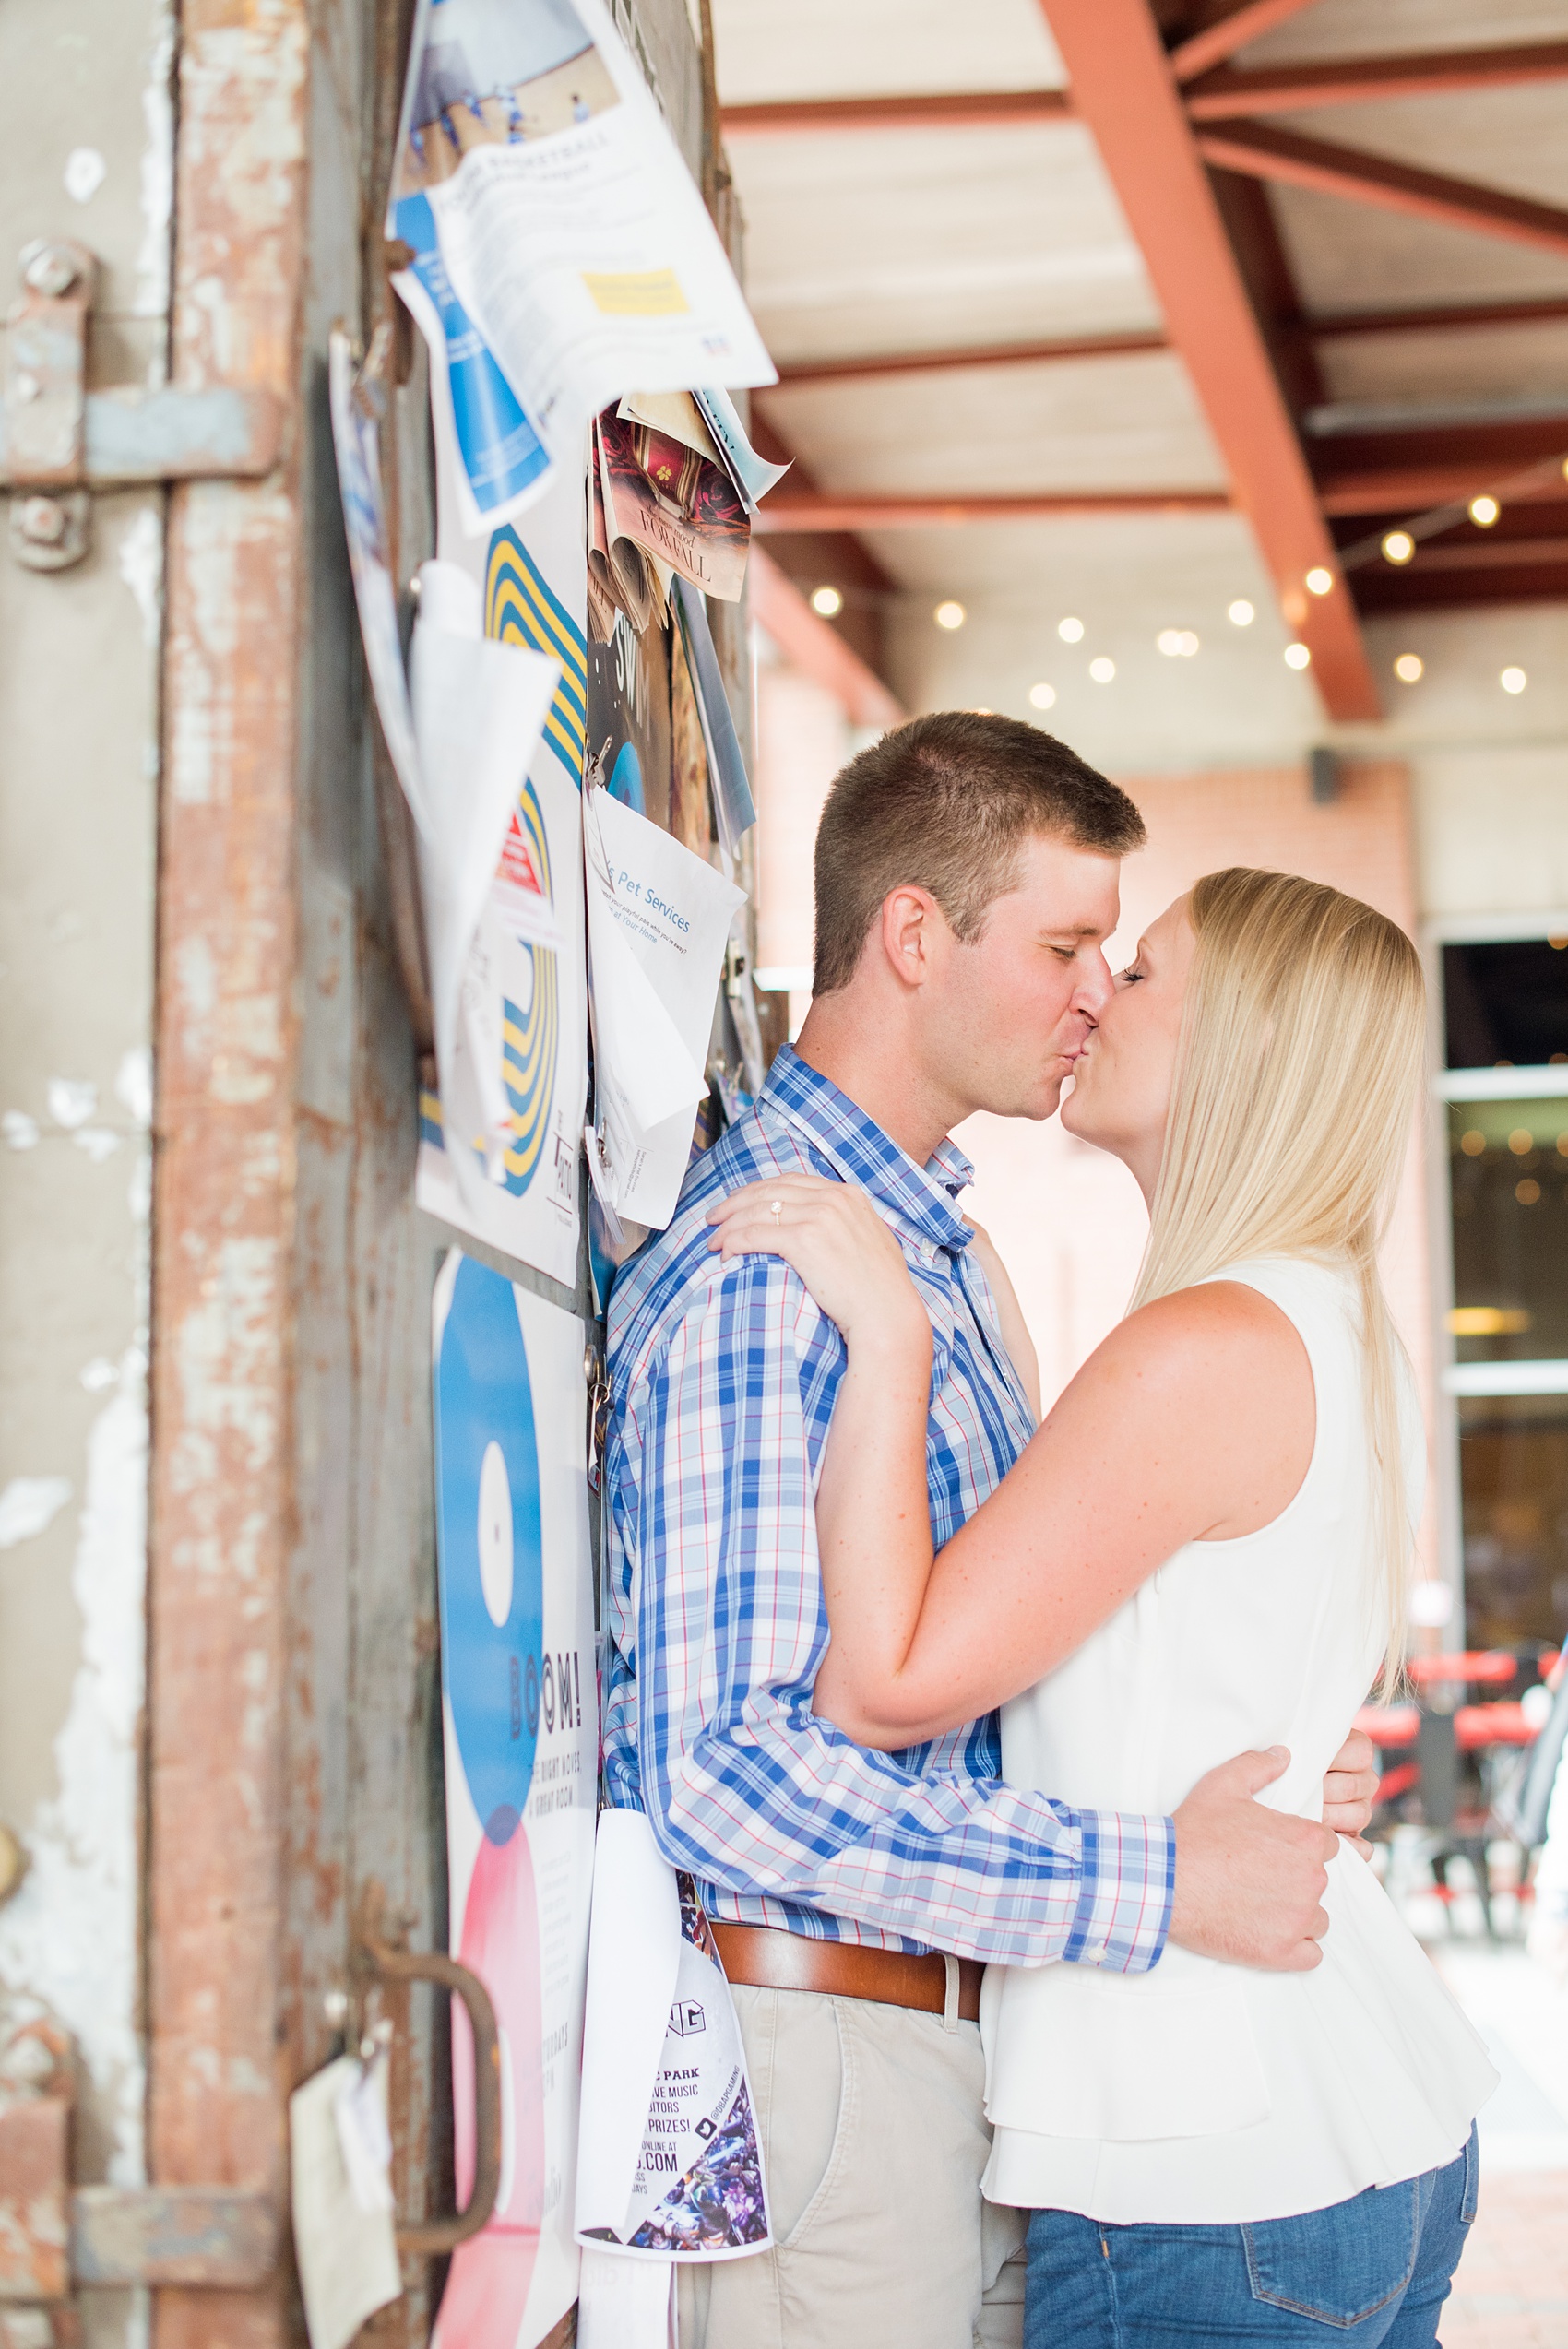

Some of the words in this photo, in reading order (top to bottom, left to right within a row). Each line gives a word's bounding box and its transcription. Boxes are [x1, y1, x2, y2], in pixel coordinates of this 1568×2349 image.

[638, 508, 673, 553] FOR
[672, 534, 712, 583] FALL
[673, 529, 695, 549] mood
[617, 871, 641, 896] Pet
[644, 888, 691, 933] Services
[613, 910, 622, 919] at
[622, 913, 639, 931] Your
[638, 926, 658, 944] Home
[621, 904, 640, 919] playful
[638, 916, 650, 927] pals
[649, 924, 661, 935] while
[673, 941, 688, 955] away?
[508, 1651, 582, 1741] BOOM!
[555, 1785, 574, 1811] ROOM
[665, 1999, 707, 2038] NG
[663, 2067, 700, 2081] PARK
[668, 2083, 699, 2098] MUSIC
[648, 2118, 691, 2134] PRIZES!
[641, 2140, 666, 2152] ONLINE
[669, 2141, 677, 2152] AT
